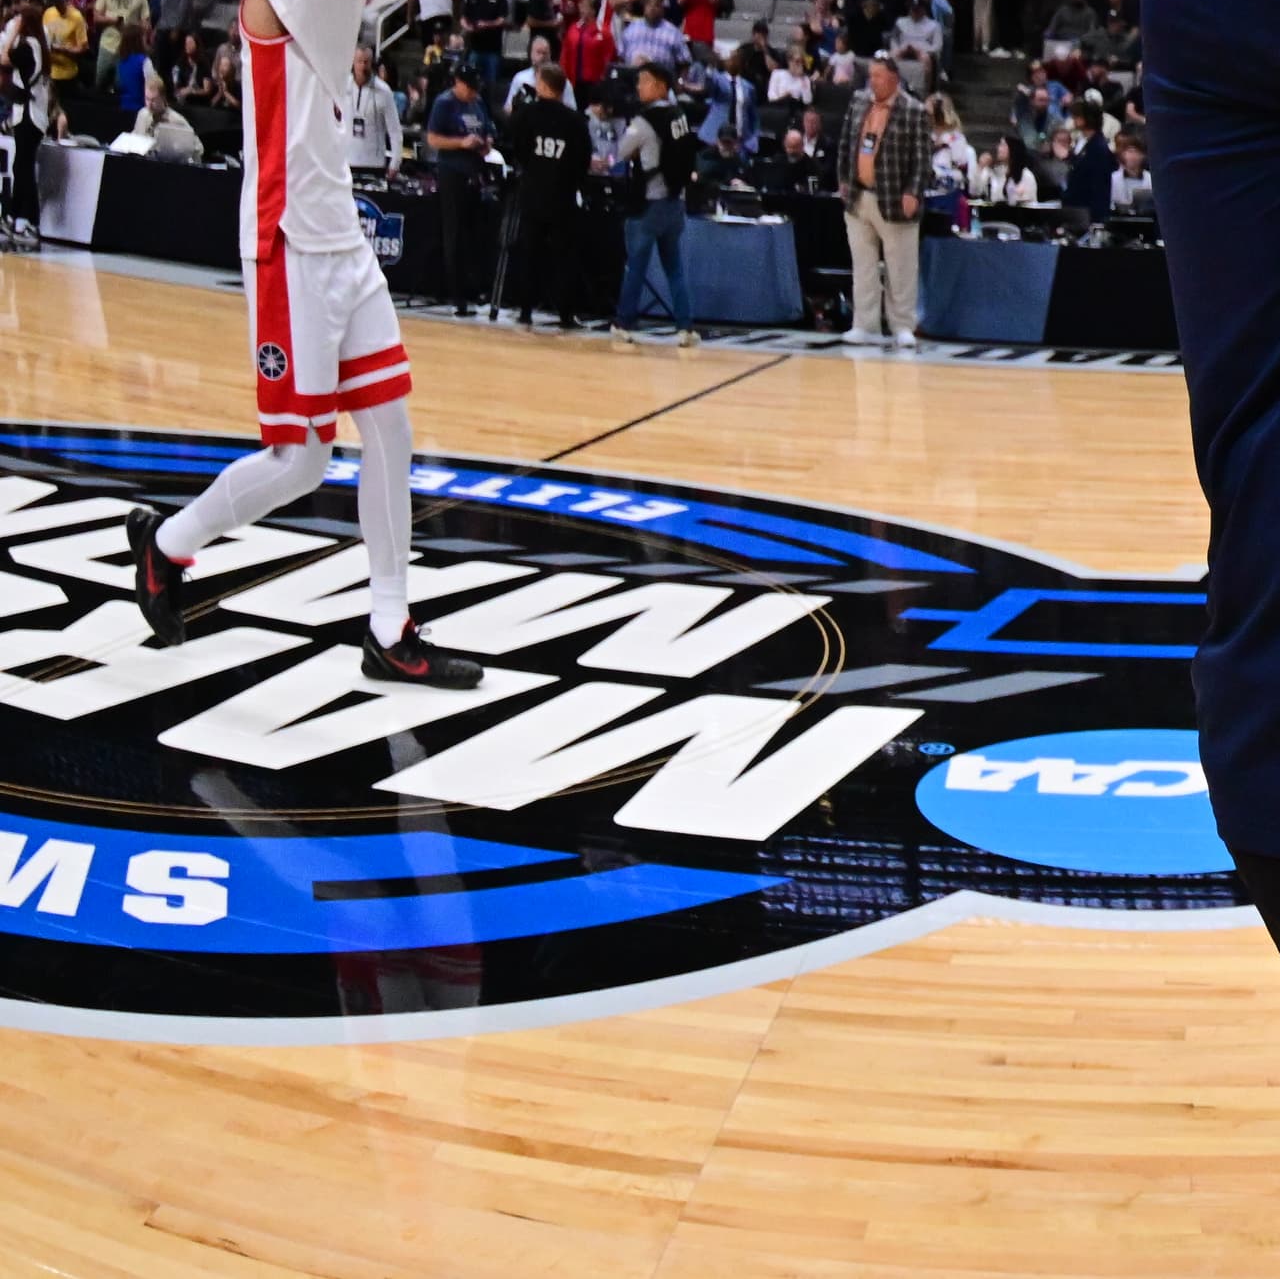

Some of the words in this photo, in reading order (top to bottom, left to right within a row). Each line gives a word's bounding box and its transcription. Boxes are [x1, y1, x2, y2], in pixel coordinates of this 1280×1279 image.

[535, 136, 566, 159] 197
[409, 469, 690, 521] ELITE
[945, 755, 1211, 798] CAA
